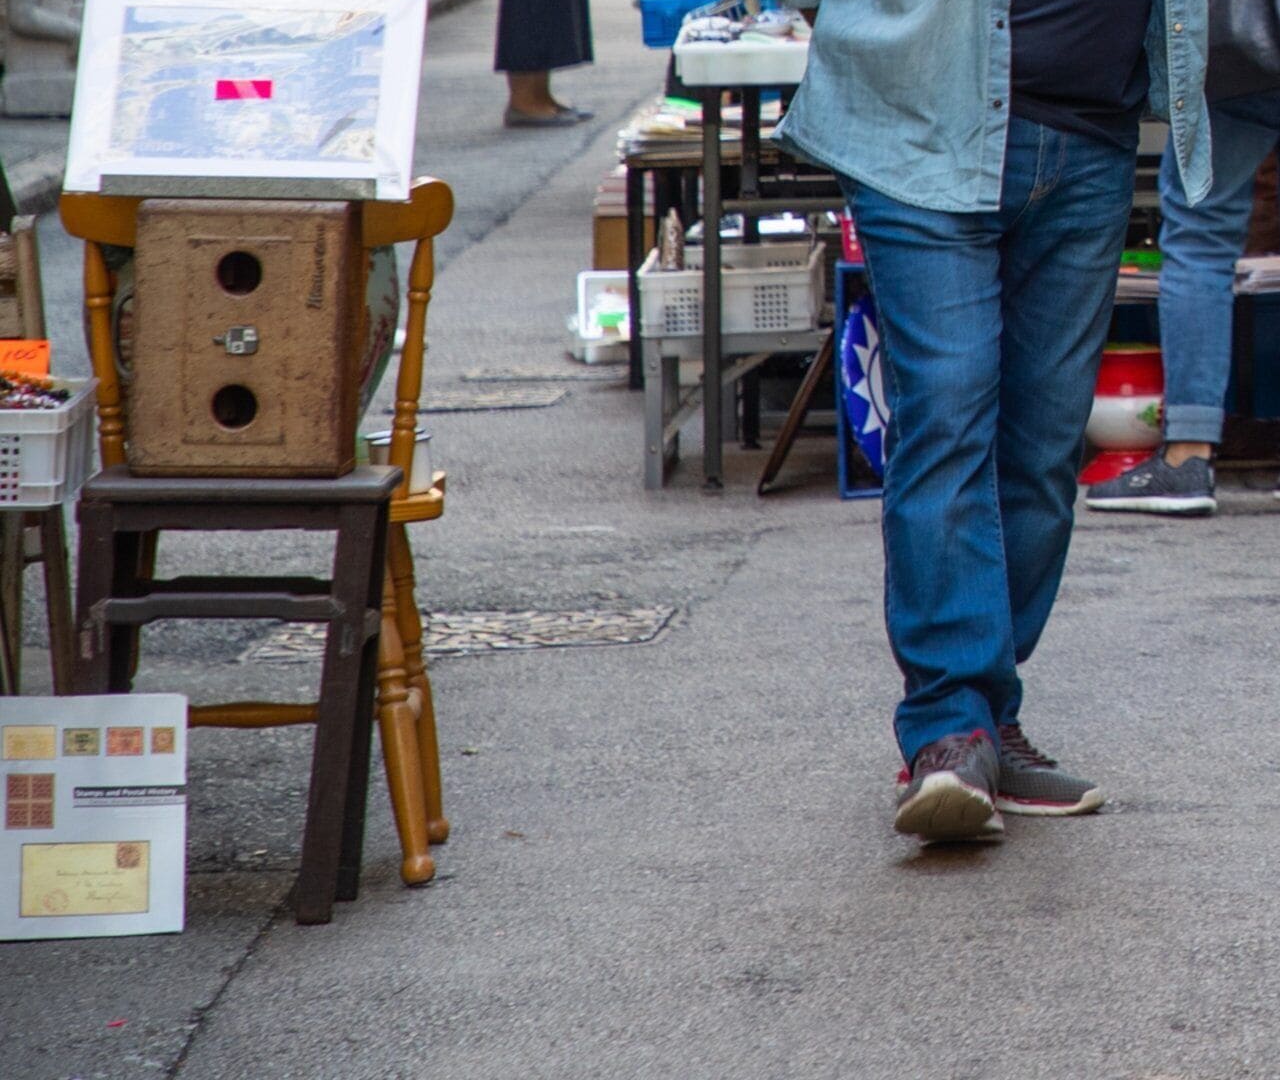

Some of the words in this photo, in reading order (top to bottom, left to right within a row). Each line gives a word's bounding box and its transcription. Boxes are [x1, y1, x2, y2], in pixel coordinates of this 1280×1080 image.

[75, 789, 103, 799] Stamps
[105, 788, 120, 798] and
[123, 787, 145, 798] Postal
[148, 786, 177, 798] History
